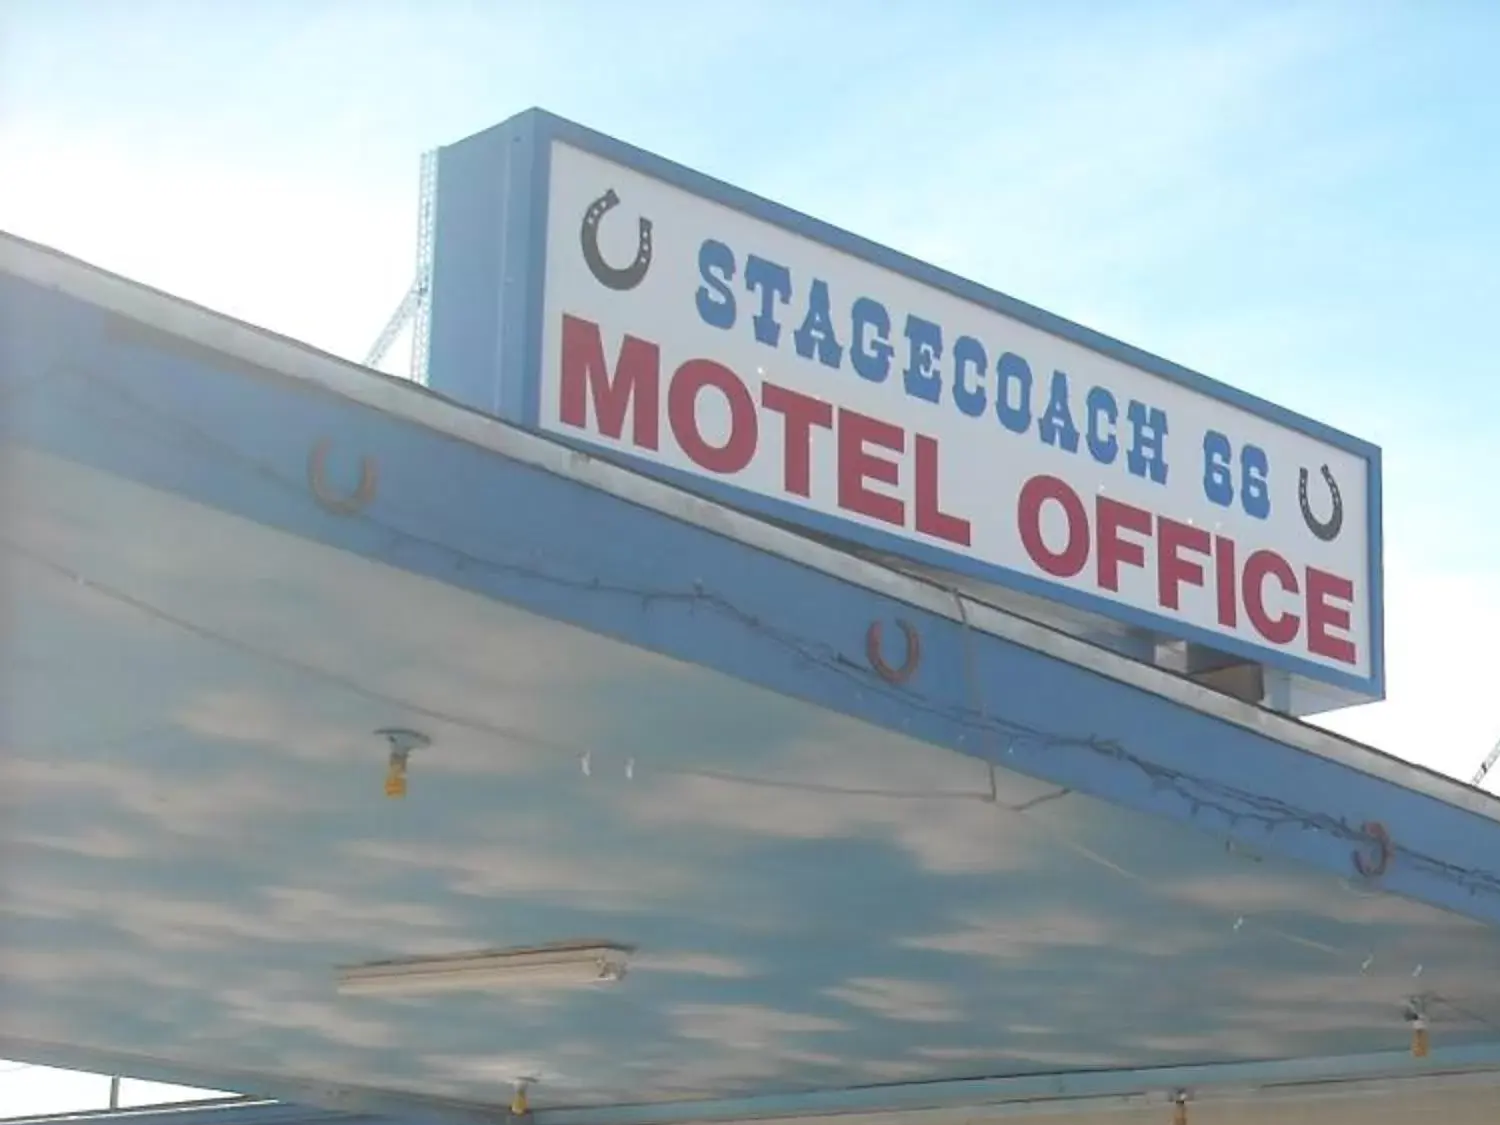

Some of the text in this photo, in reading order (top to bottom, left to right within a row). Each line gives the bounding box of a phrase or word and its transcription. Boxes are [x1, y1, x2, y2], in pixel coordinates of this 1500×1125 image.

[558, 312, 1358, 667] MOTEL OFFICE
[694, 238, 1271, 520] STAGECOACH 66
